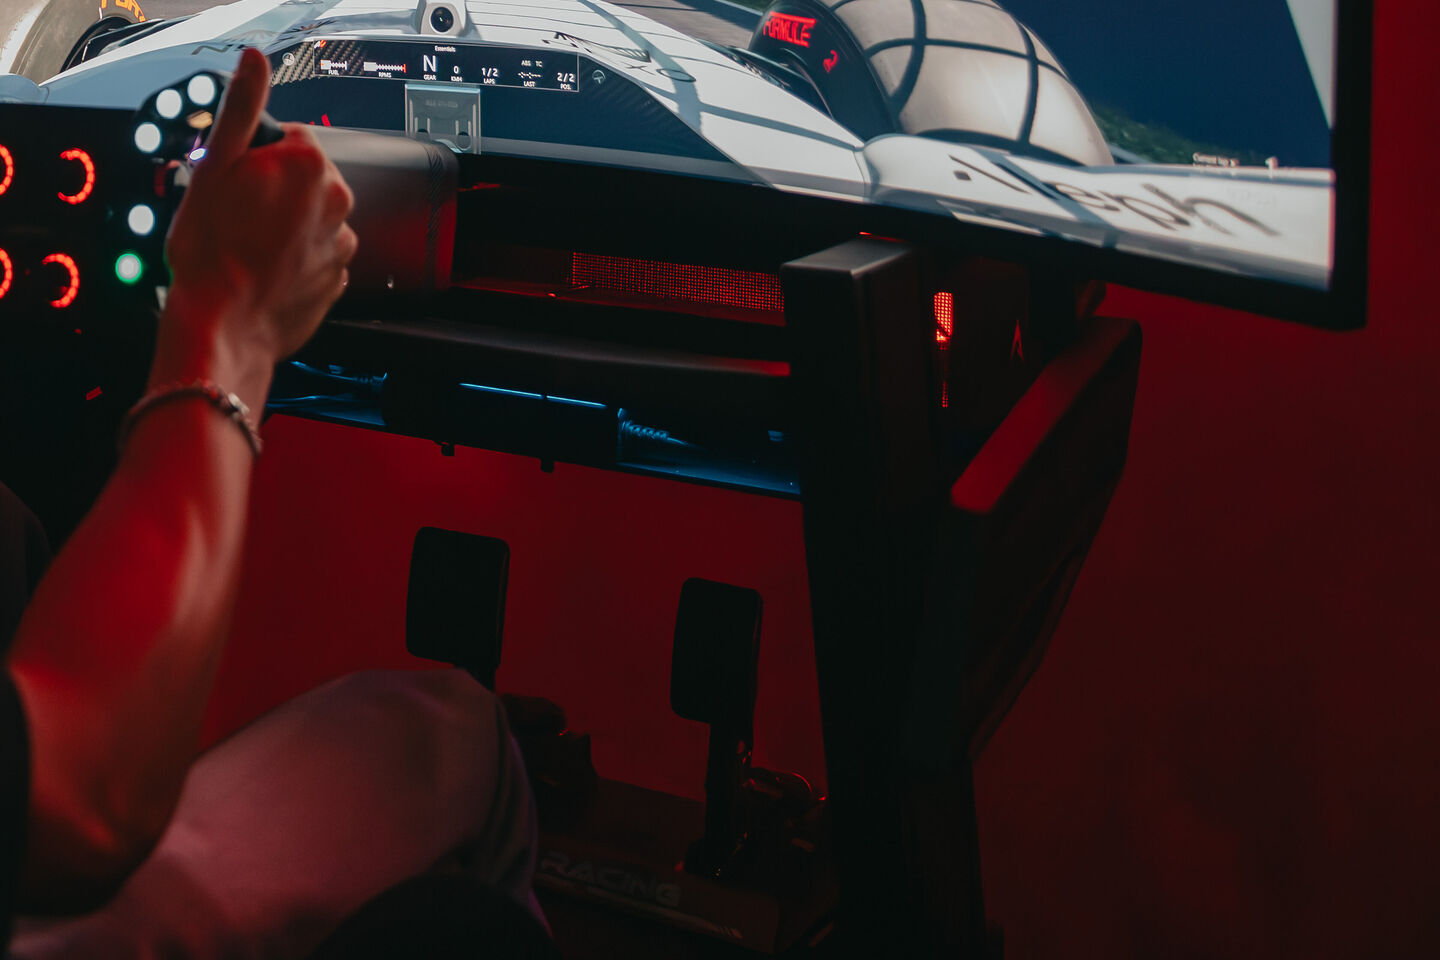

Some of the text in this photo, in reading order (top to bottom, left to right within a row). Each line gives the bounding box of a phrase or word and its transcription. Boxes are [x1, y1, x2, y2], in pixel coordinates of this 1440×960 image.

[423, 54, 438, 73] N
[481, 67, 499, 78] 1/2
[557, 72, 575, 83] 2/2
[541, 850, 681, 908] RACING
